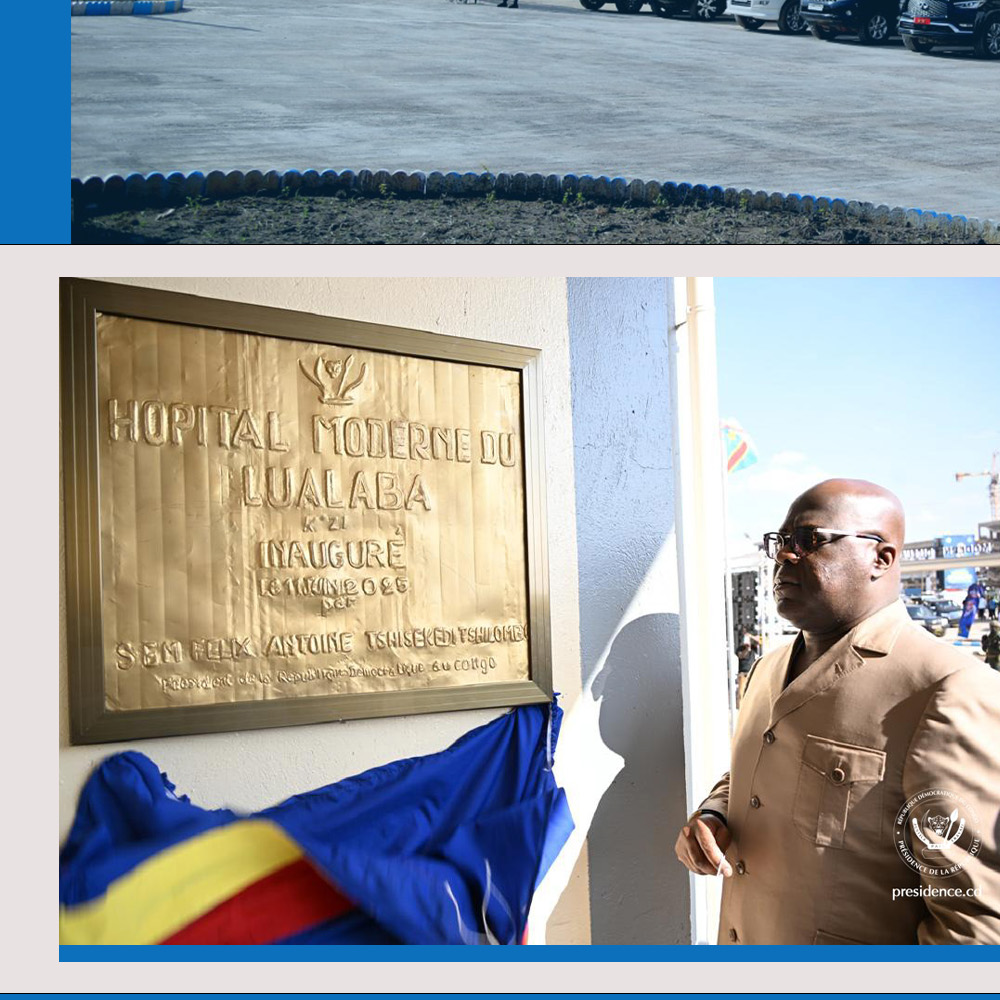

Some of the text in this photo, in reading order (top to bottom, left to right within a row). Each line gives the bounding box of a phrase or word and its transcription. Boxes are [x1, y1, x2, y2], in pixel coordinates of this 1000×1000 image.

[108, 399, 516, 467] HOPITAL MODERNE DU
[242, 464, 432, 511] LUALABA
